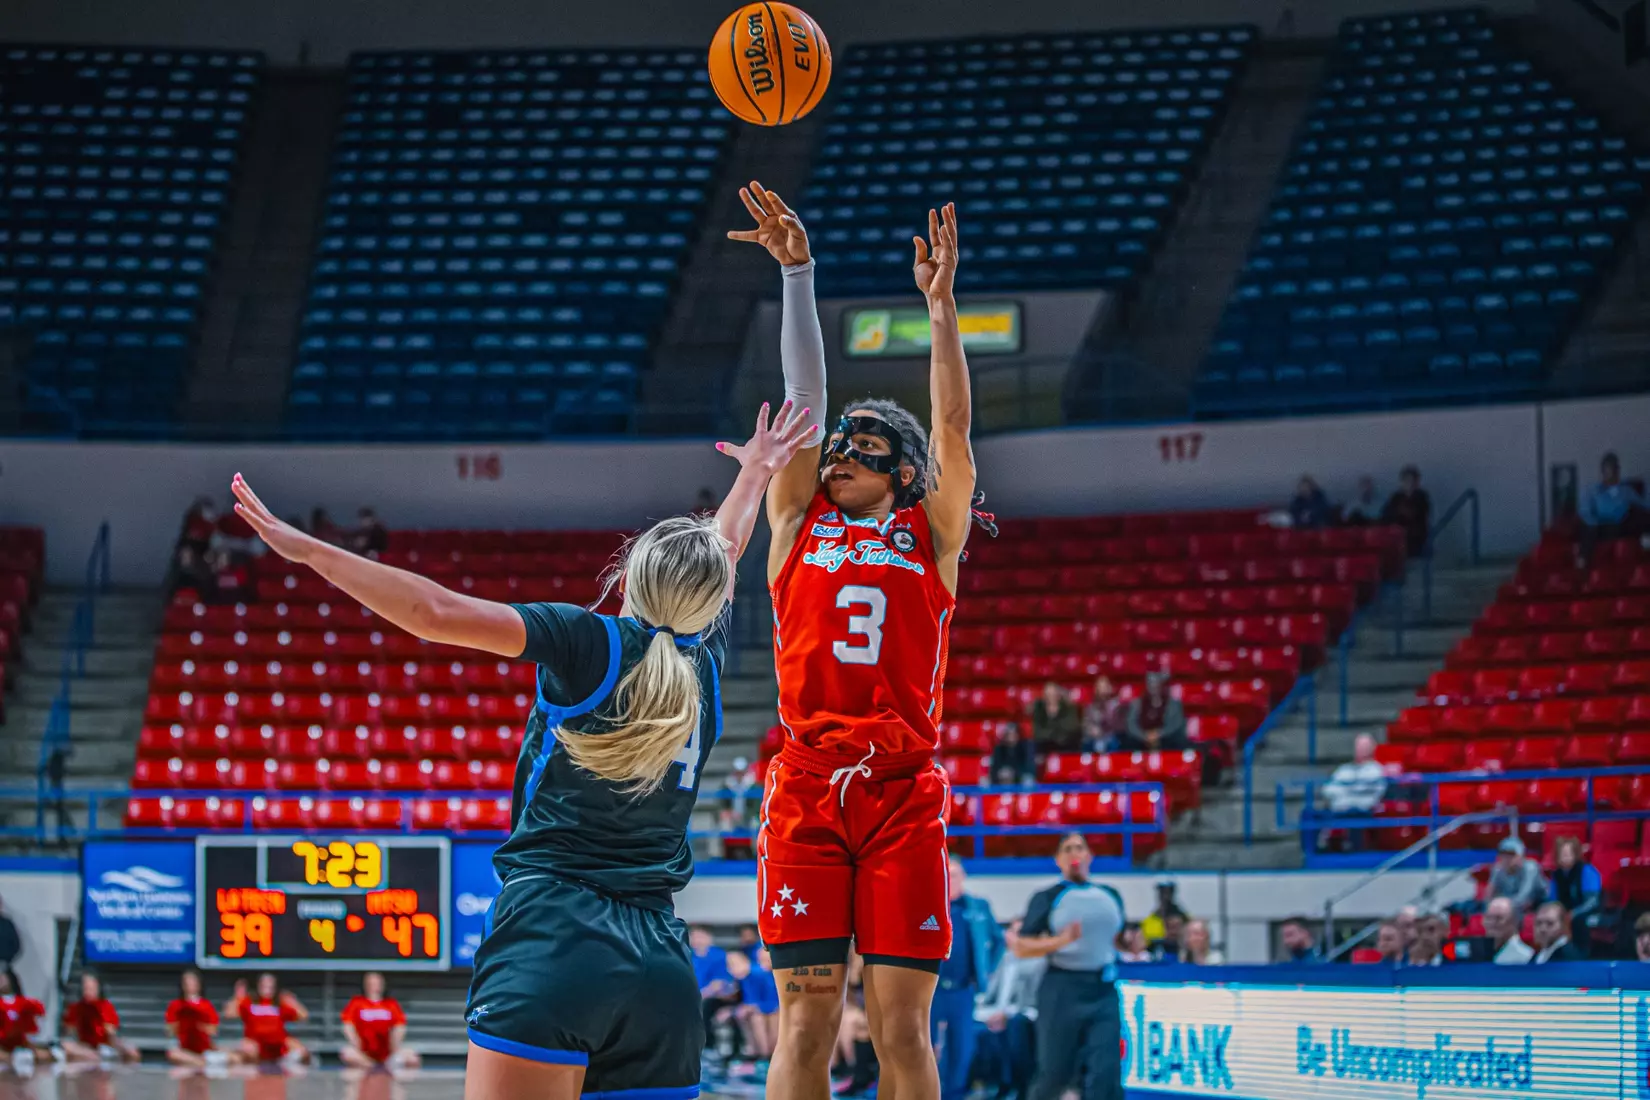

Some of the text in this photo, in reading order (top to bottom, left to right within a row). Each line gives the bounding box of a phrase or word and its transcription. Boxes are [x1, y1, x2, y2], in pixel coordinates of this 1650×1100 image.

[744, 9, 775, 96] Wilson
[455, 453, 502, 480] 116
[1159, 432, 1204, 462] 117
[803, 540, 849, 572] Lady
[832, 584, 887, 665] 3
[292, 841, 381, 888] 7:23
[219, 912, 273, 958] 39
[309, 918, 336, 952] 4
[382, 912, 438, 957] 47
[1297, 1025, 1533, 1100] Be Uncomplicated
